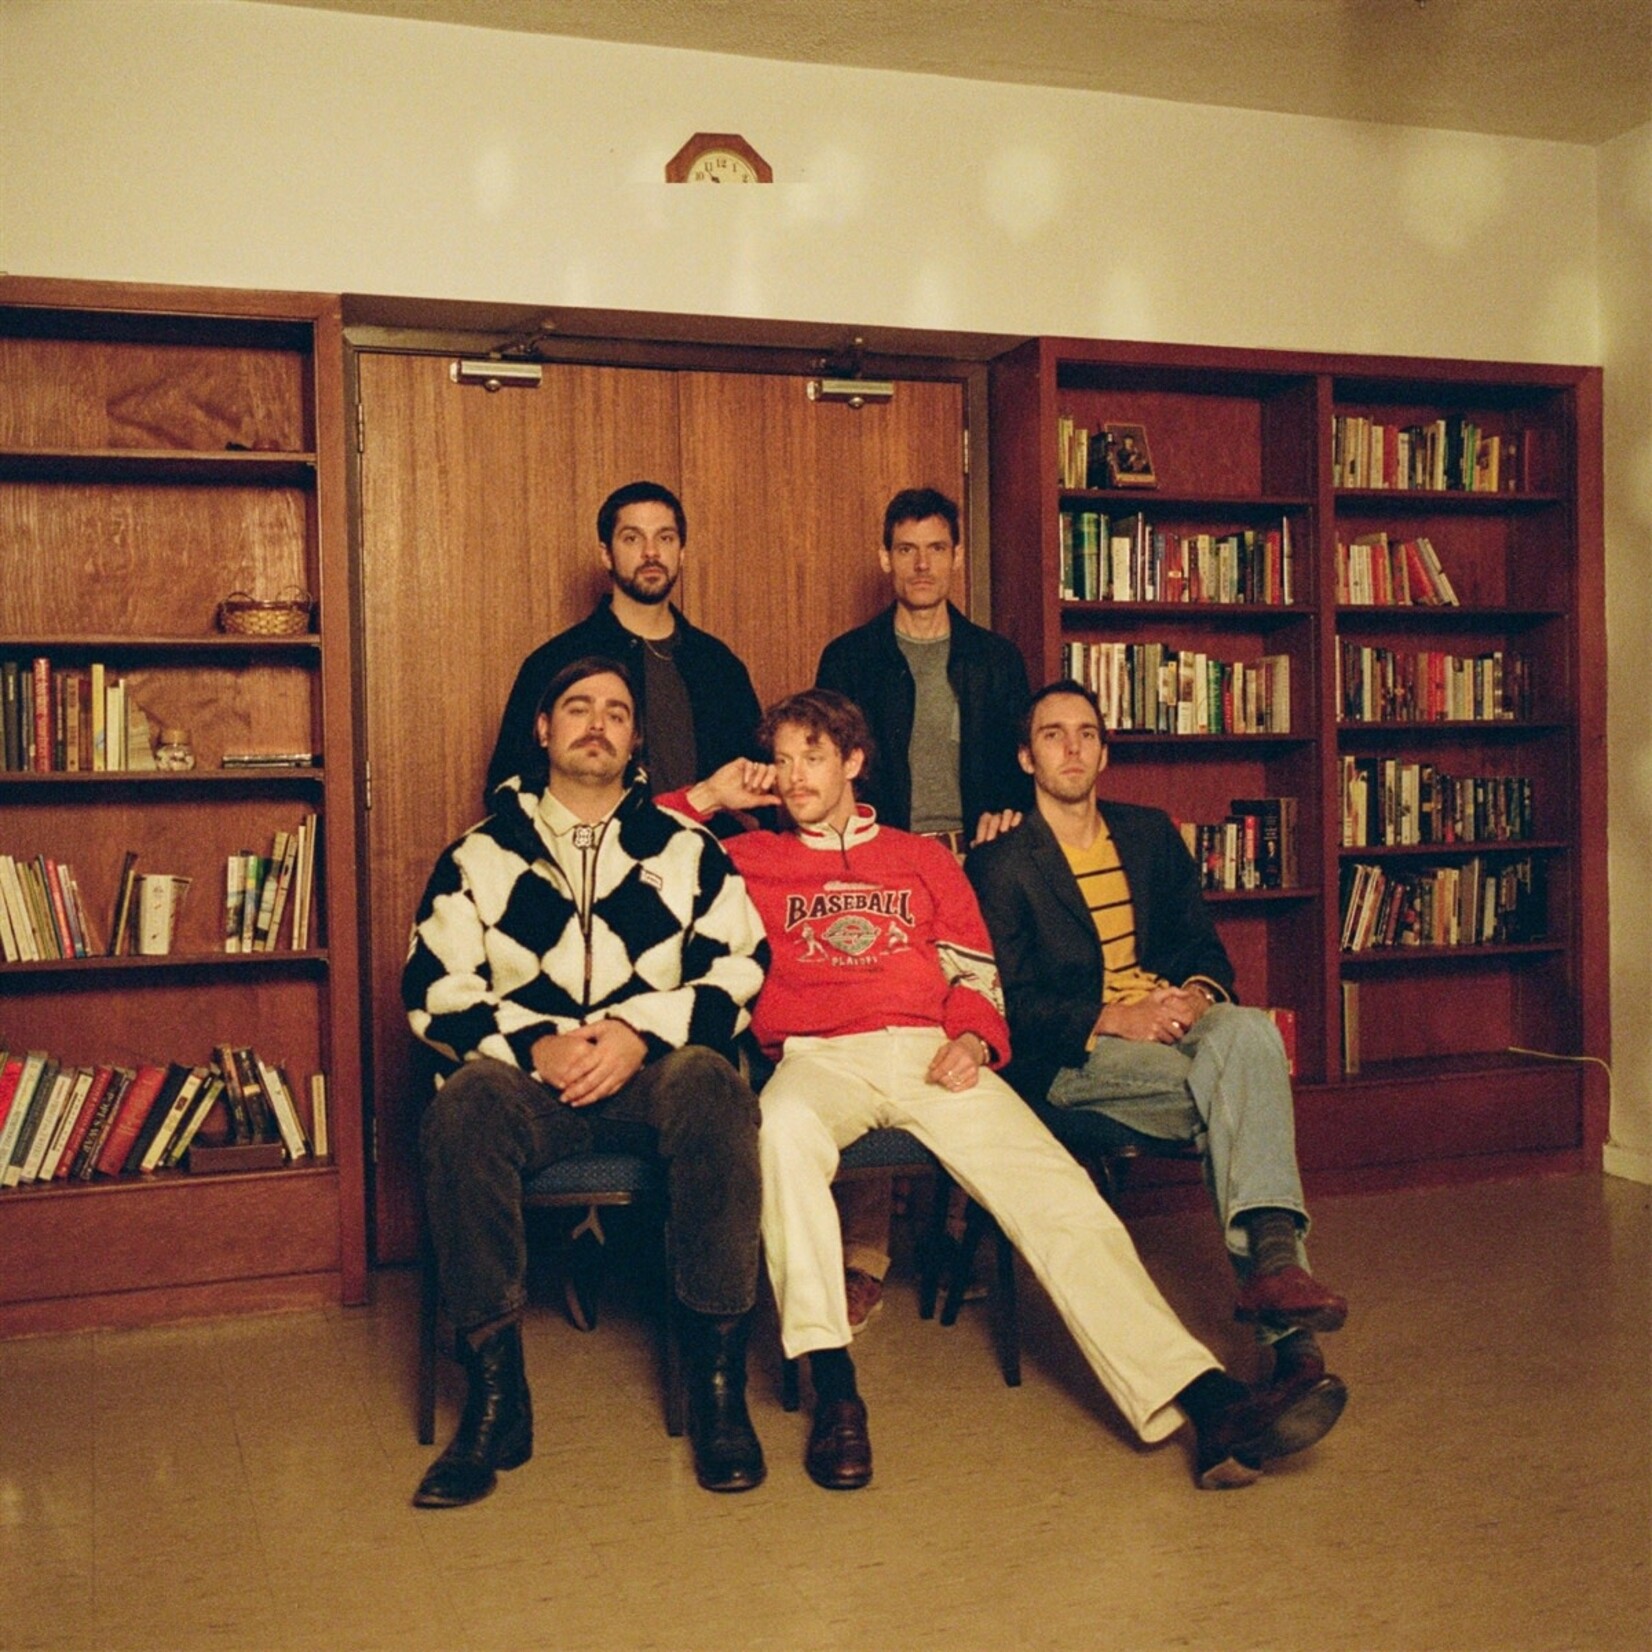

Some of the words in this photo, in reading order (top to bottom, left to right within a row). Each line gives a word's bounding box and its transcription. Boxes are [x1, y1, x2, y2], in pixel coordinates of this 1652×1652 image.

[704, 162, 712, 172] 11
[716, 159, 727, 169] 12
[733, 163, 738, 172] 1
[695, 172, 704, 181] 10
[786, 890, 915, 932] BASEBALL
